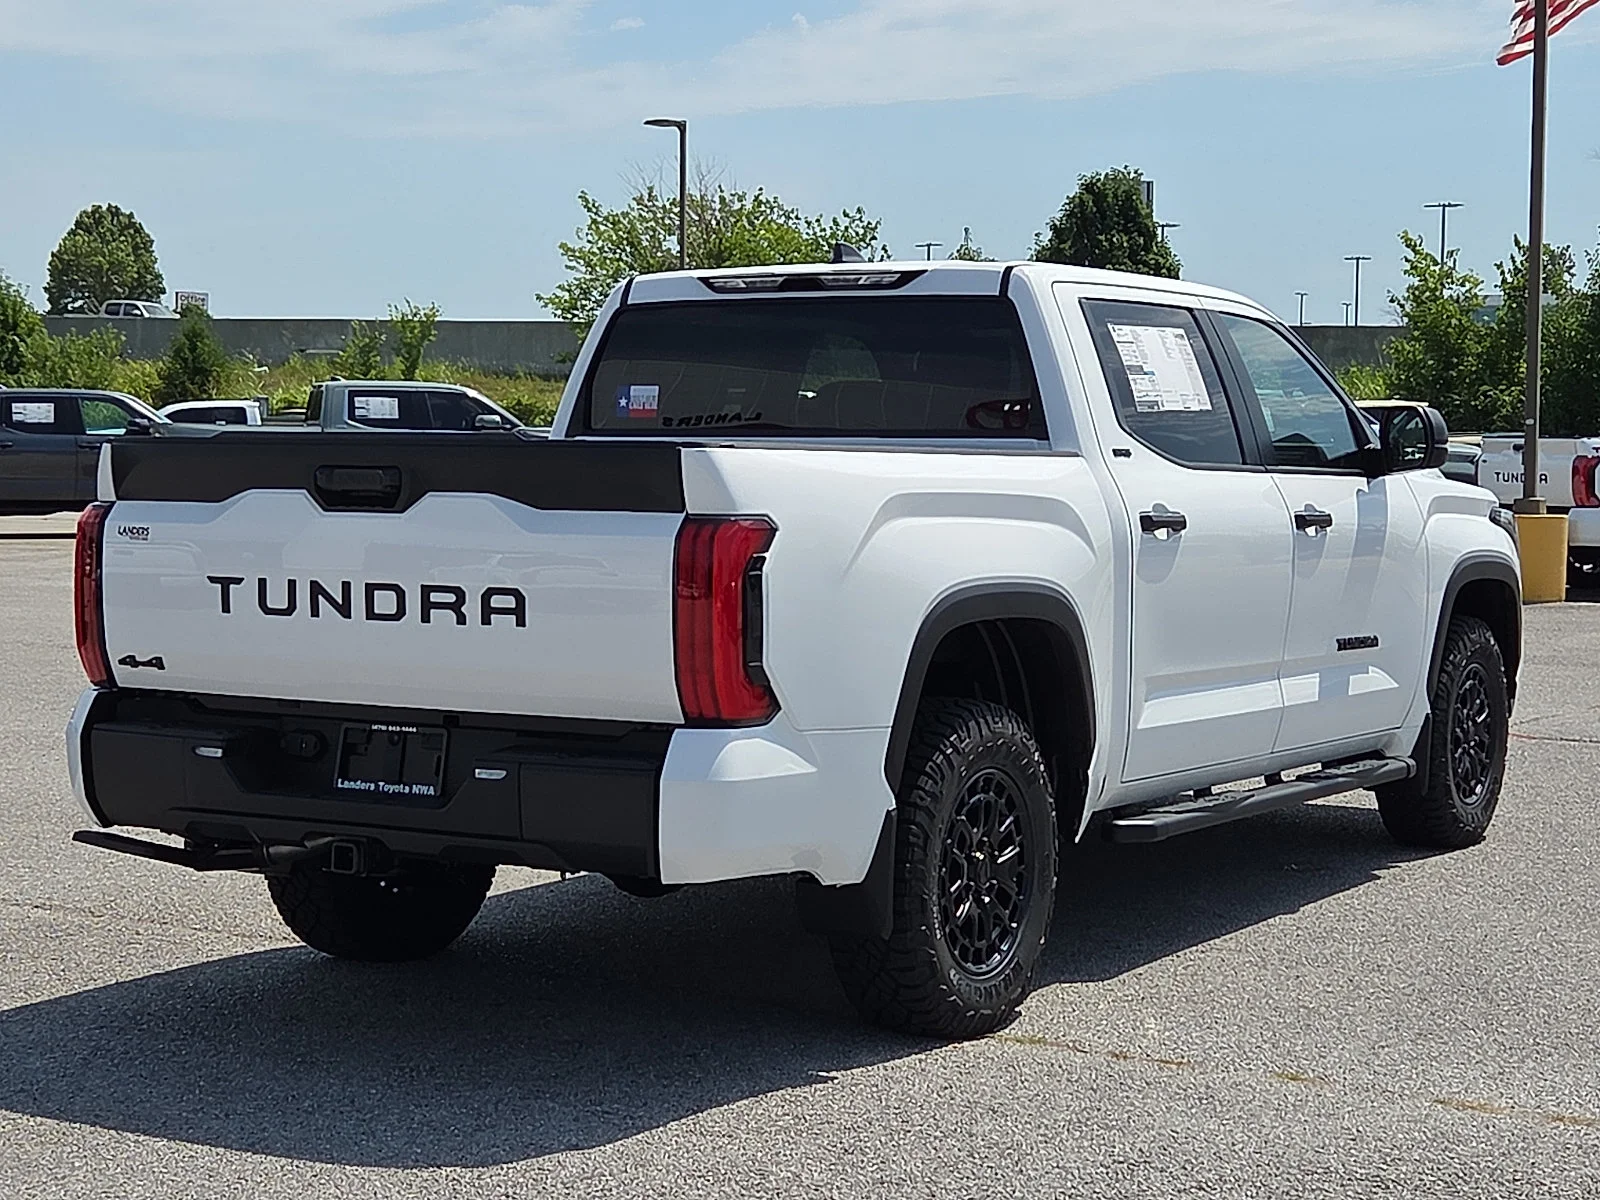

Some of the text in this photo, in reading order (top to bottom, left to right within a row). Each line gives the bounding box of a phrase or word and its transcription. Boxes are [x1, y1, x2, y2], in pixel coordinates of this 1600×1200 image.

[1494, 471, 1548, 485] TUNDA
[206, 575, 527, 628] TUNDRA
[337, 778, 435, 796] Landers Toyota NWA
